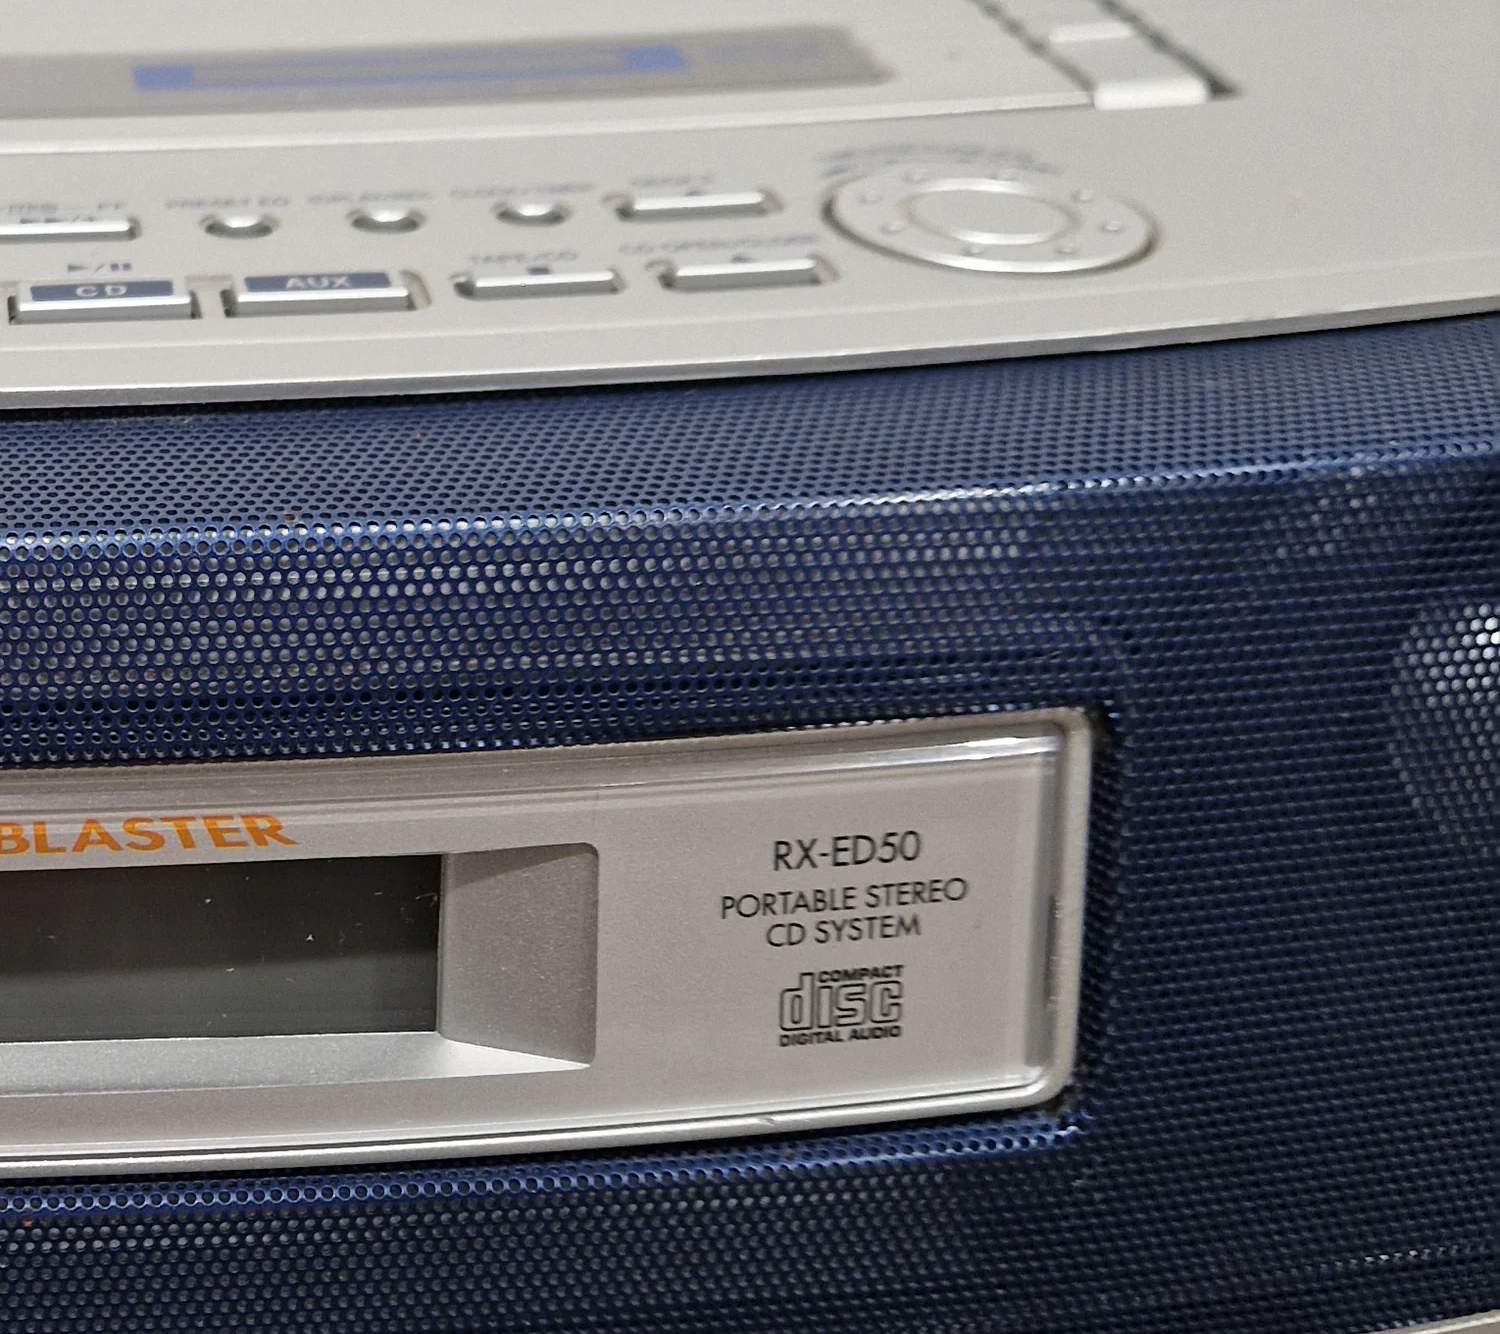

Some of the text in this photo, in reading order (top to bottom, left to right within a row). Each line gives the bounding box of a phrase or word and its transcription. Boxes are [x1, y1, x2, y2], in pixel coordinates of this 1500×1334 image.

[75, 284, 128, 298] CD
[284, 274, 351, 290] AUX
[773, 830, 922, 872] RX-ED50
[721, 877, 969, 919] PORTABLE STEREO
[766, 914, 922, 948] CD SYSTEM
[819, 964, 905, 984] COMPACT
[779, 1025, 903, 1048] DIGITAL AUDIO
